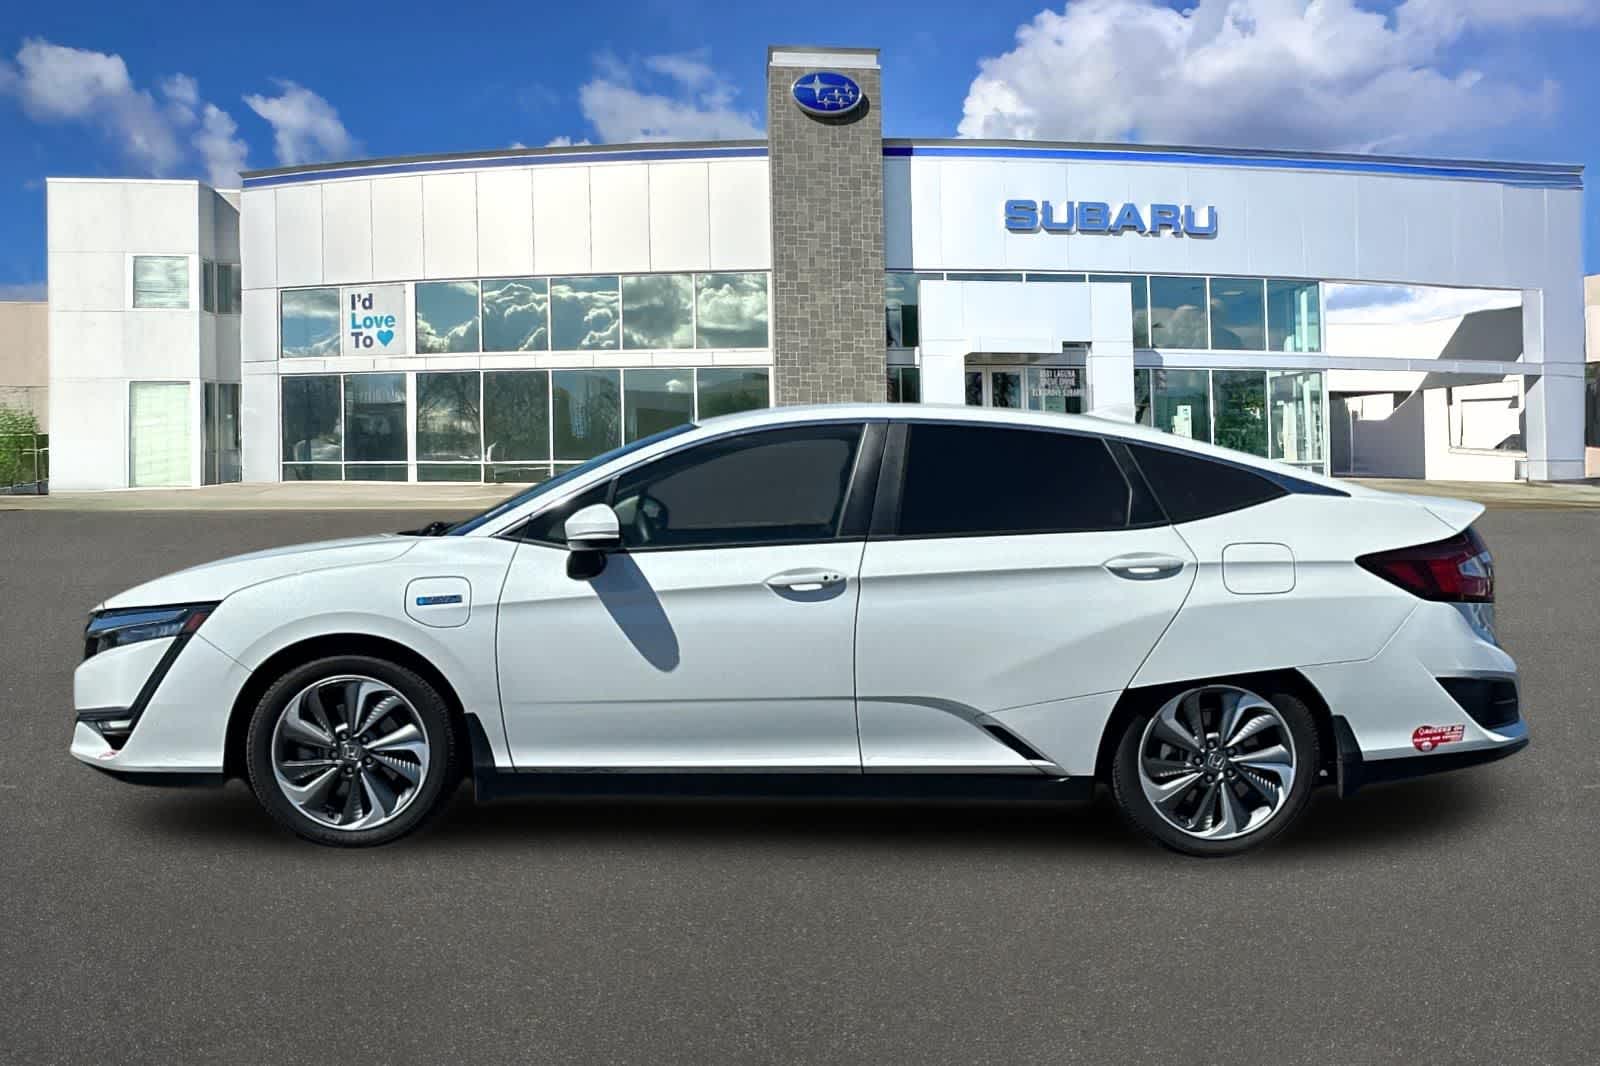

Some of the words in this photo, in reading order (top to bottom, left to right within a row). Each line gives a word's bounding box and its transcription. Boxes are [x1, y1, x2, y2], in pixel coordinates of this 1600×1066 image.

[1005, 200, 1217, 237] SUBARU
[351, 293, 373, 310] I'd
[351, 312, 396, 329] Love
[351, 331, 374, 349] To
